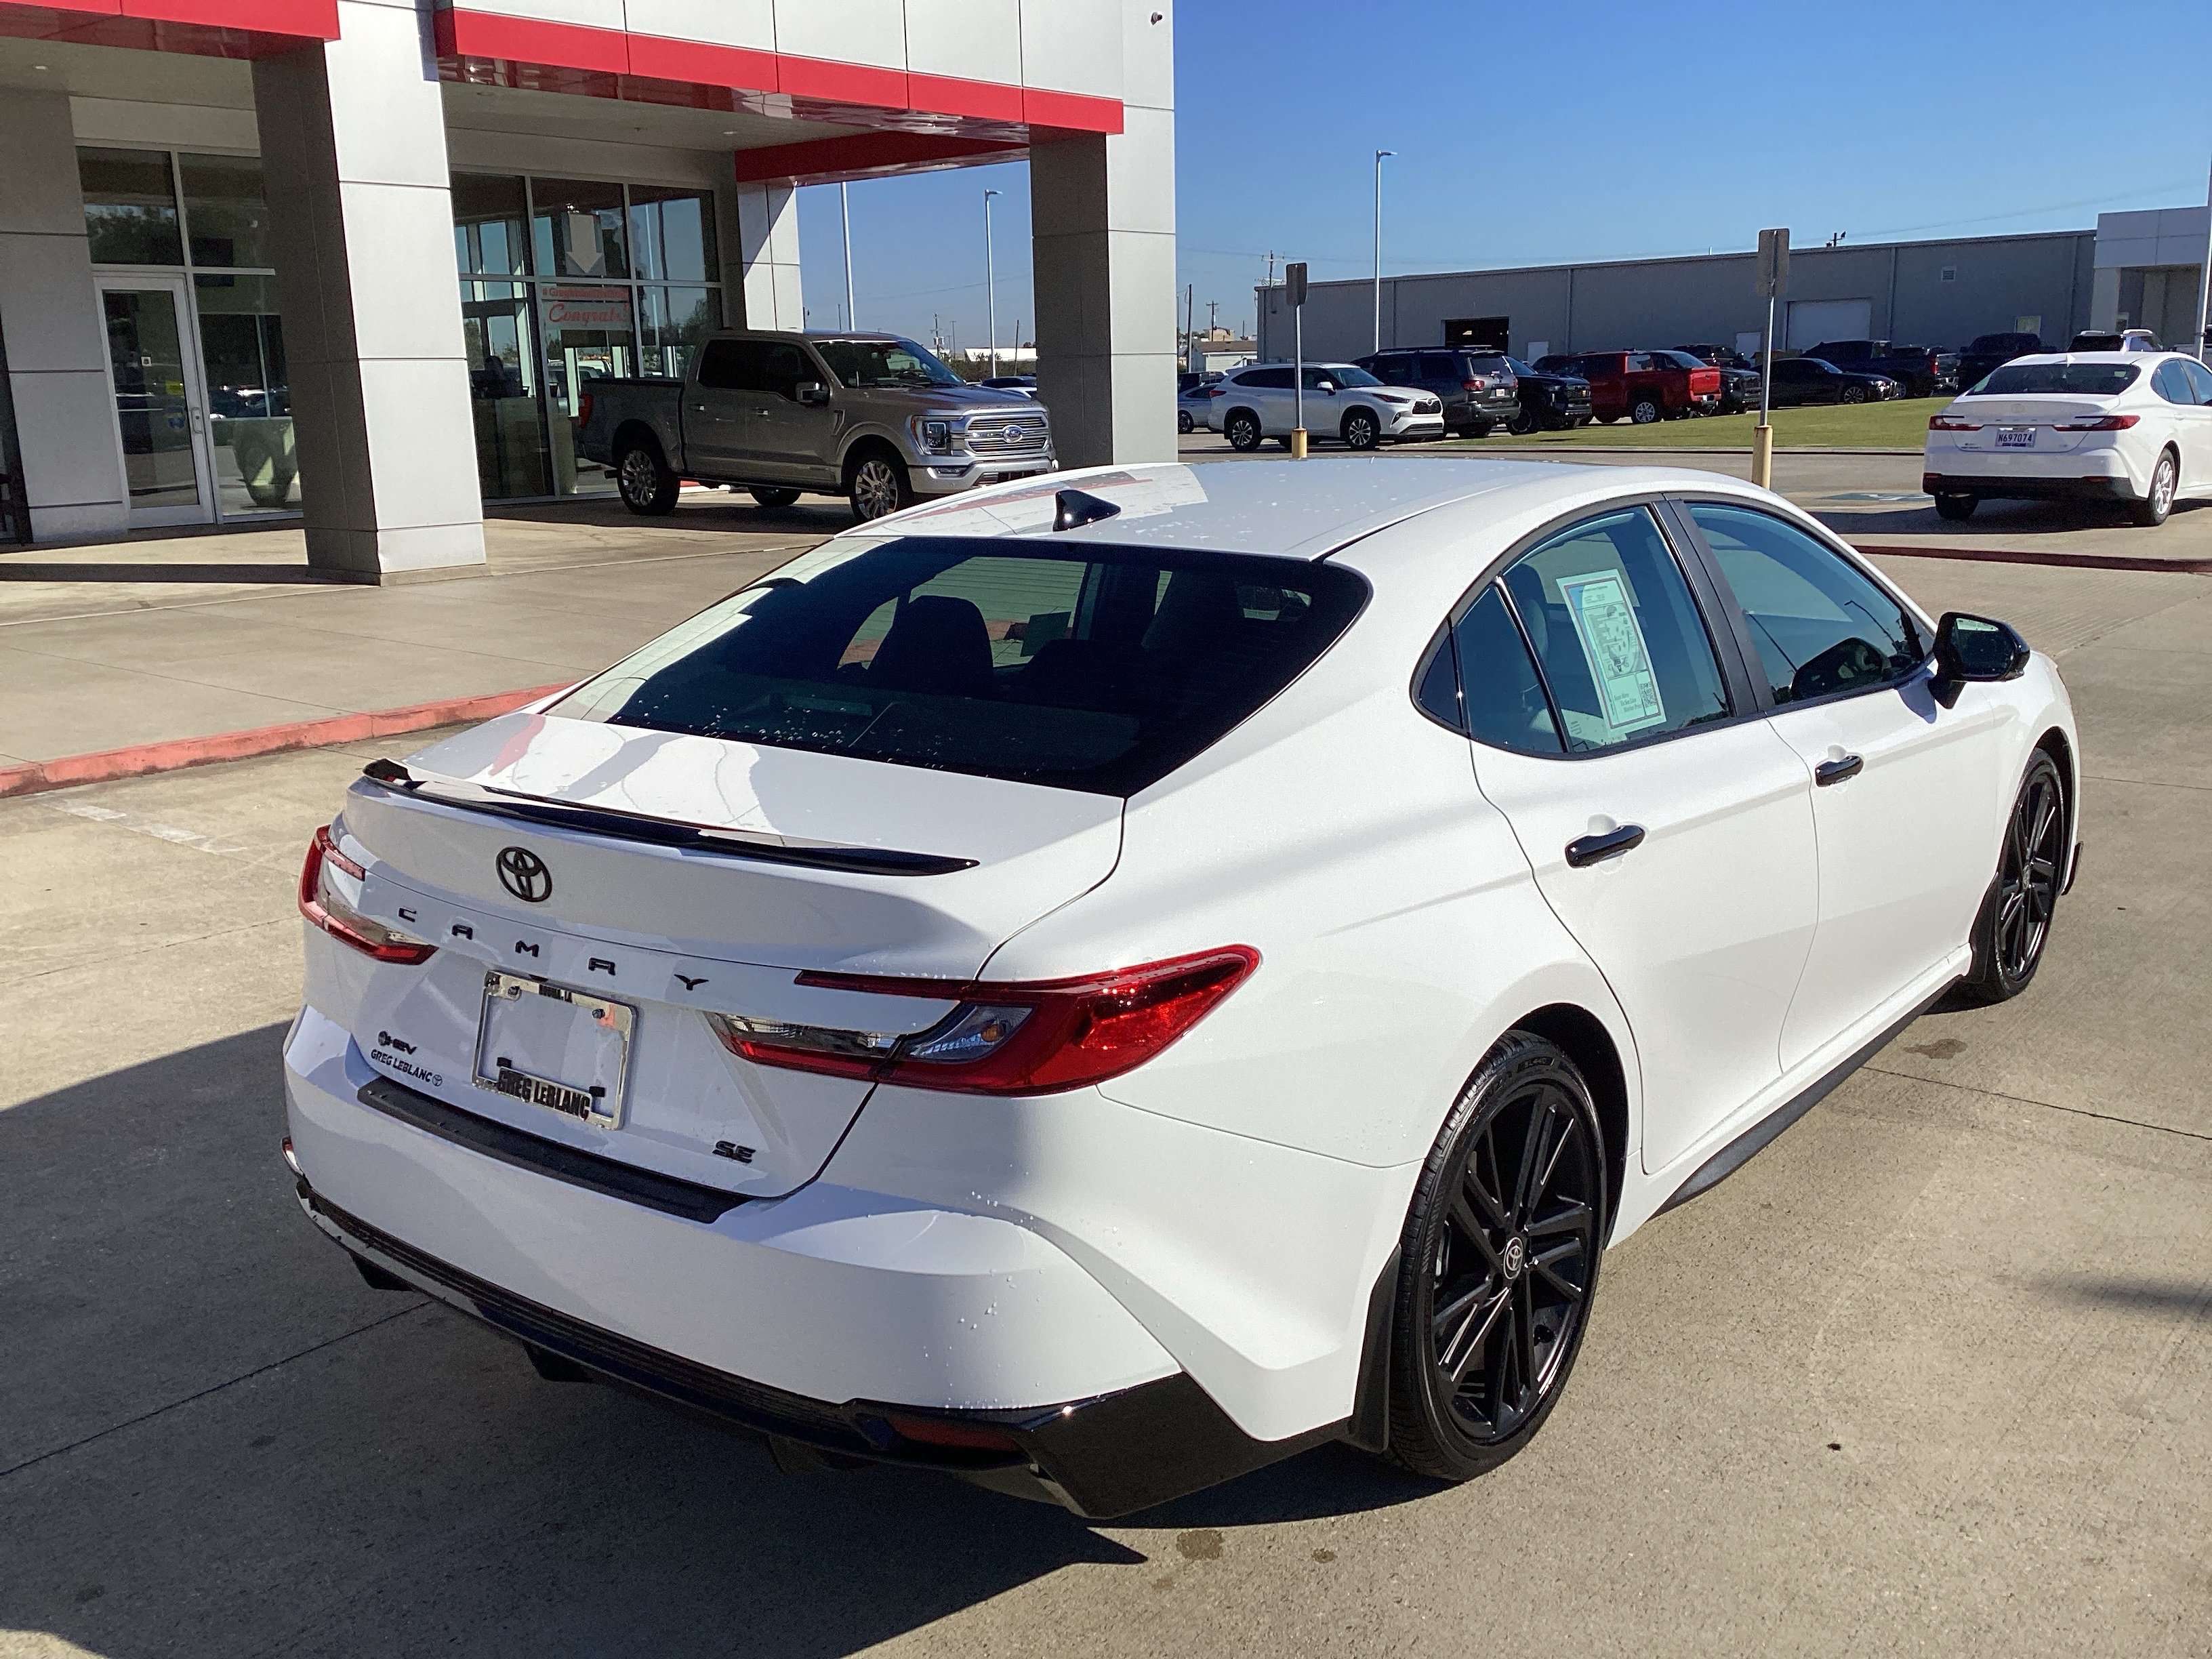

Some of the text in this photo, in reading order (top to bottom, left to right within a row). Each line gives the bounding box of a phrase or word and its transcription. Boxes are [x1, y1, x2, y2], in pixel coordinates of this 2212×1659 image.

[398, 907, 709, 991] CAMRY
[371, 1048, 433, 1082] GREG LEBLANC
[497, 1069, 531, 1103] GREG
[712, 1141, 756, 1164] SE
